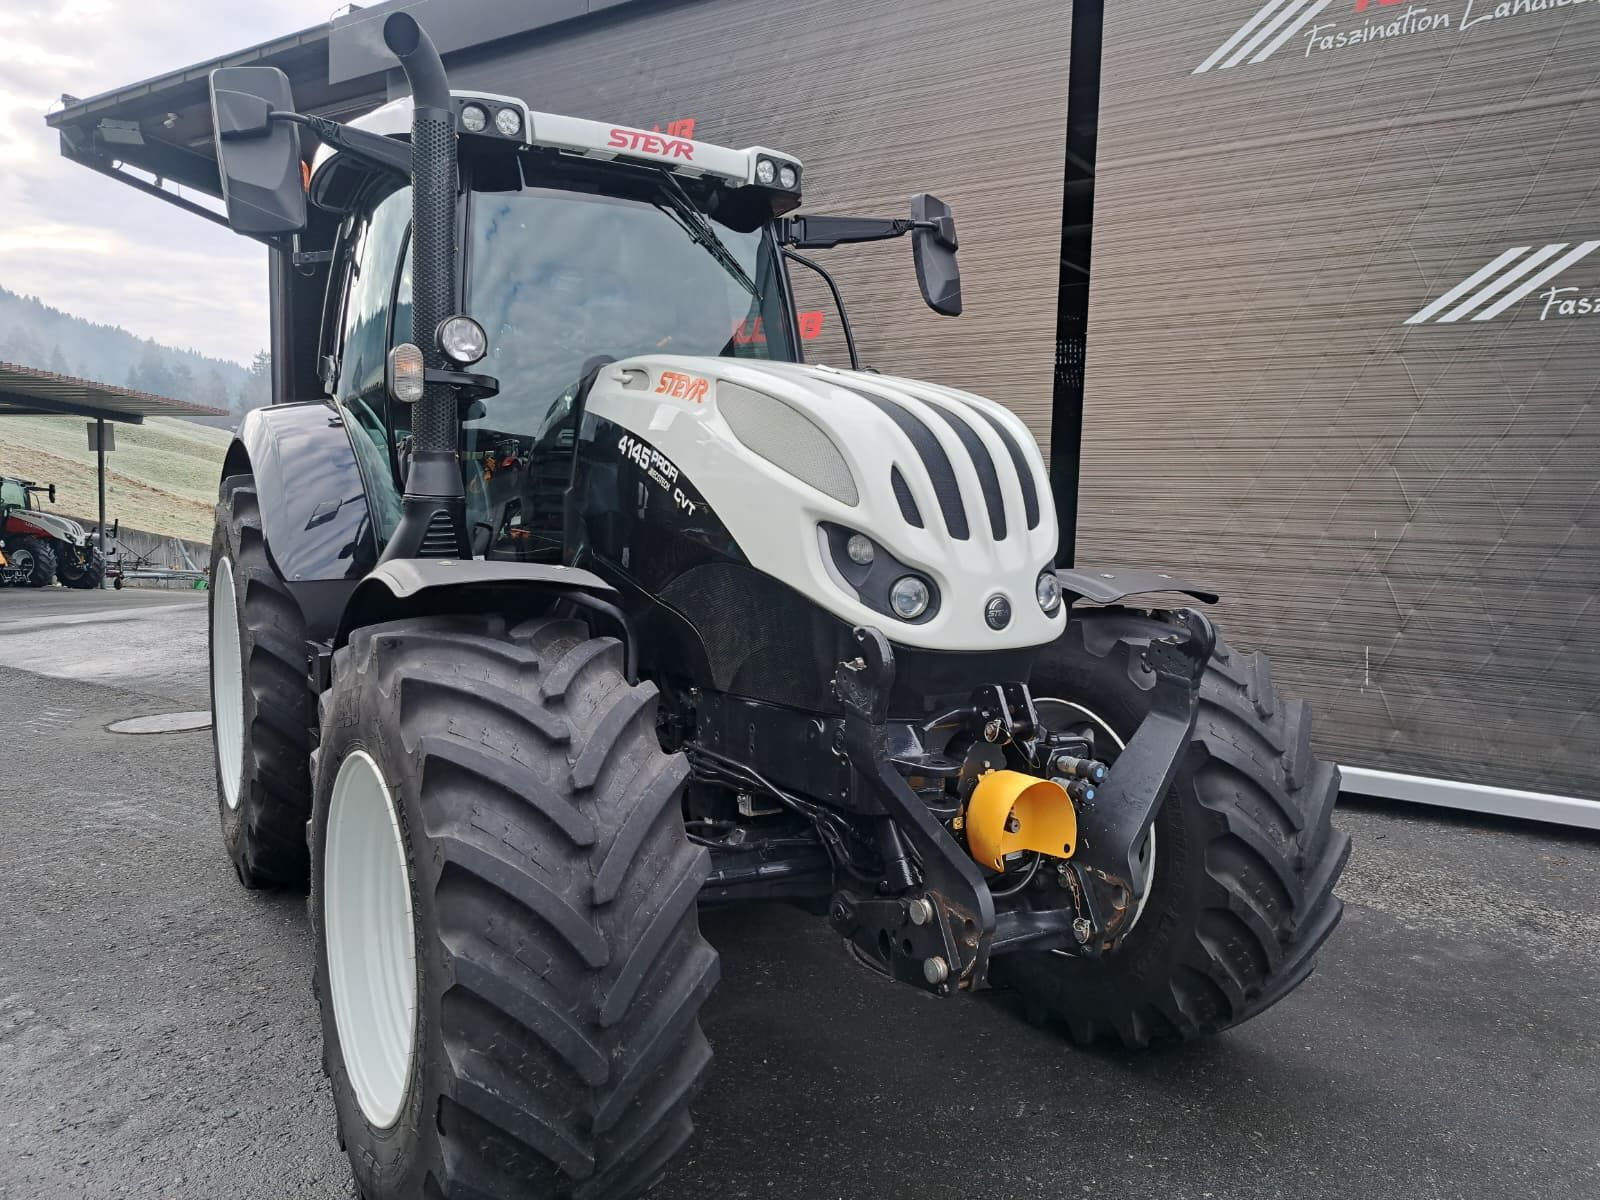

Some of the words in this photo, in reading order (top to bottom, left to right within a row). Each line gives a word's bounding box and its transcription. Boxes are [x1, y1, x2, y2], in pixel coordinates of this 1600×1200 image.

[1303, 5, 1450, 58] Faszination
[607, 128, 695, 161] STEYR
[655, 371, 709, 403] STEYR
[618, 435, 651, 470] 4145
[650, 450, 679, 484] PROFI
[673, 487, 696, 516] CVT
